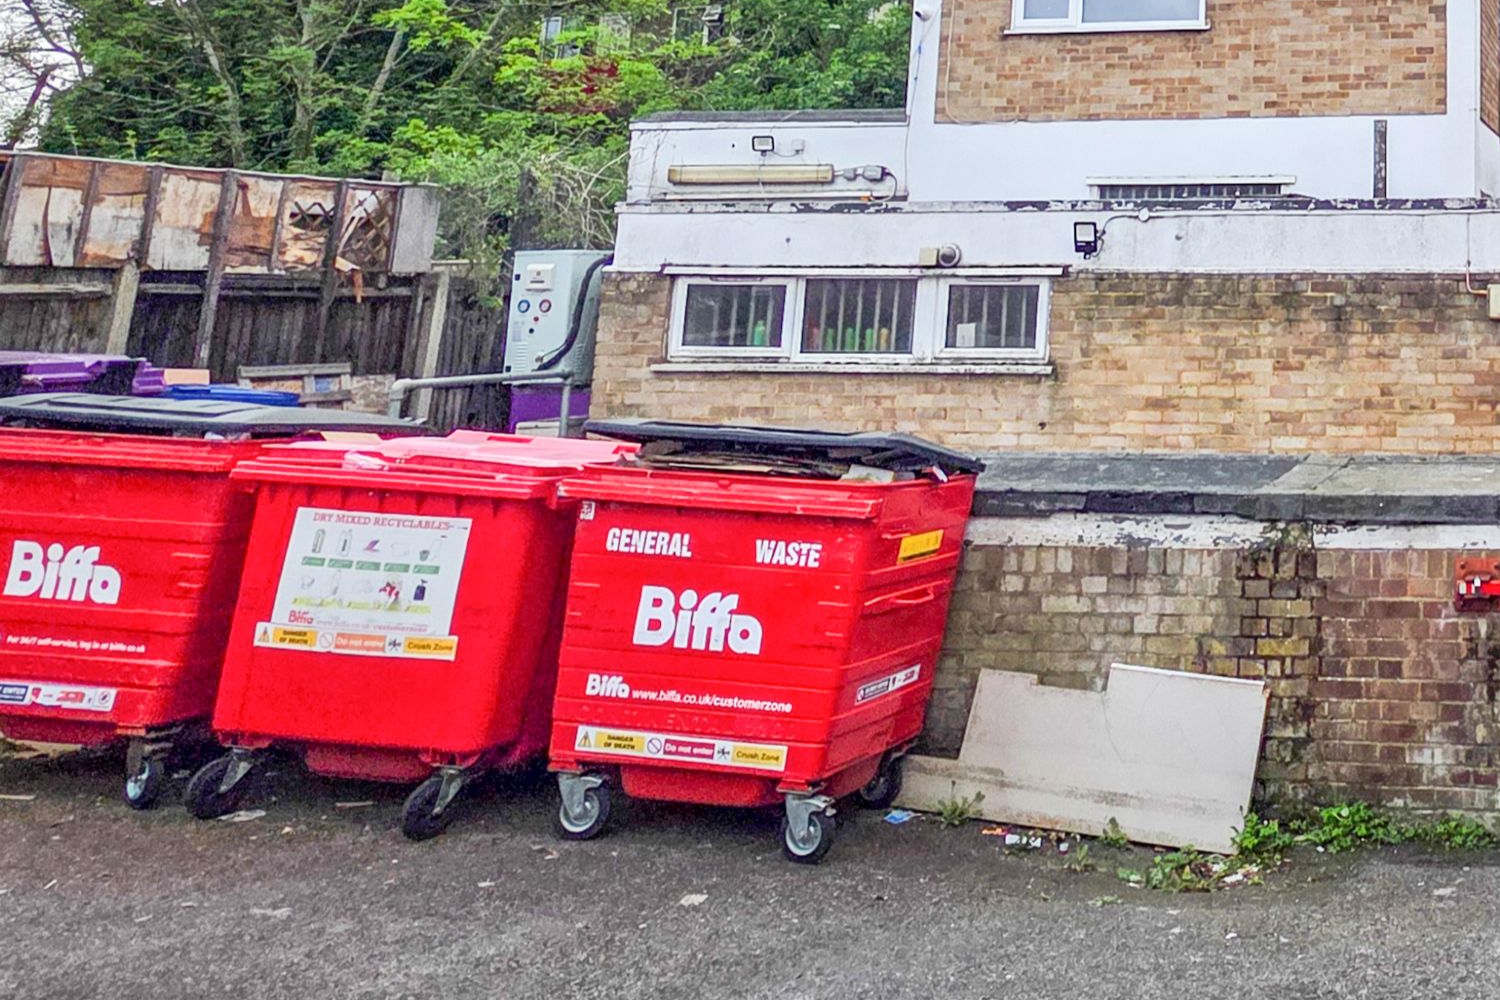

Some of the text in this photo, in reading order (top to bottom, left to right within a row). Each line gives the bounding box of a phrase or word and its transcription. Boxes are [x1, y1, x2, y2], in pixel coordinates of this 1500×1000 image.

[313, 512, 450, 531] DRY MIXED RECYCLABLES
[606, 527, 823, 568] GENERAL WASTE
[2, 540, 121, 605] Biffa
[287, 610, 314, 625] Biffa
[632, 585, 763, 655] Biffa
[336, 637, 347, 645] Do
[348, 638, 362, 646] not
[407, 641, 453, 652] Crush Zone
[585, 673, 793, 713] Biffa www.biffa.co.uk/customerzone
[607, 734, 634, 743] DANGER
[603, 741, 636, 751] OF DEATH
[664, 743, 714, 756] Do not enter
[736, 750, 780, 763] Crush Zone
